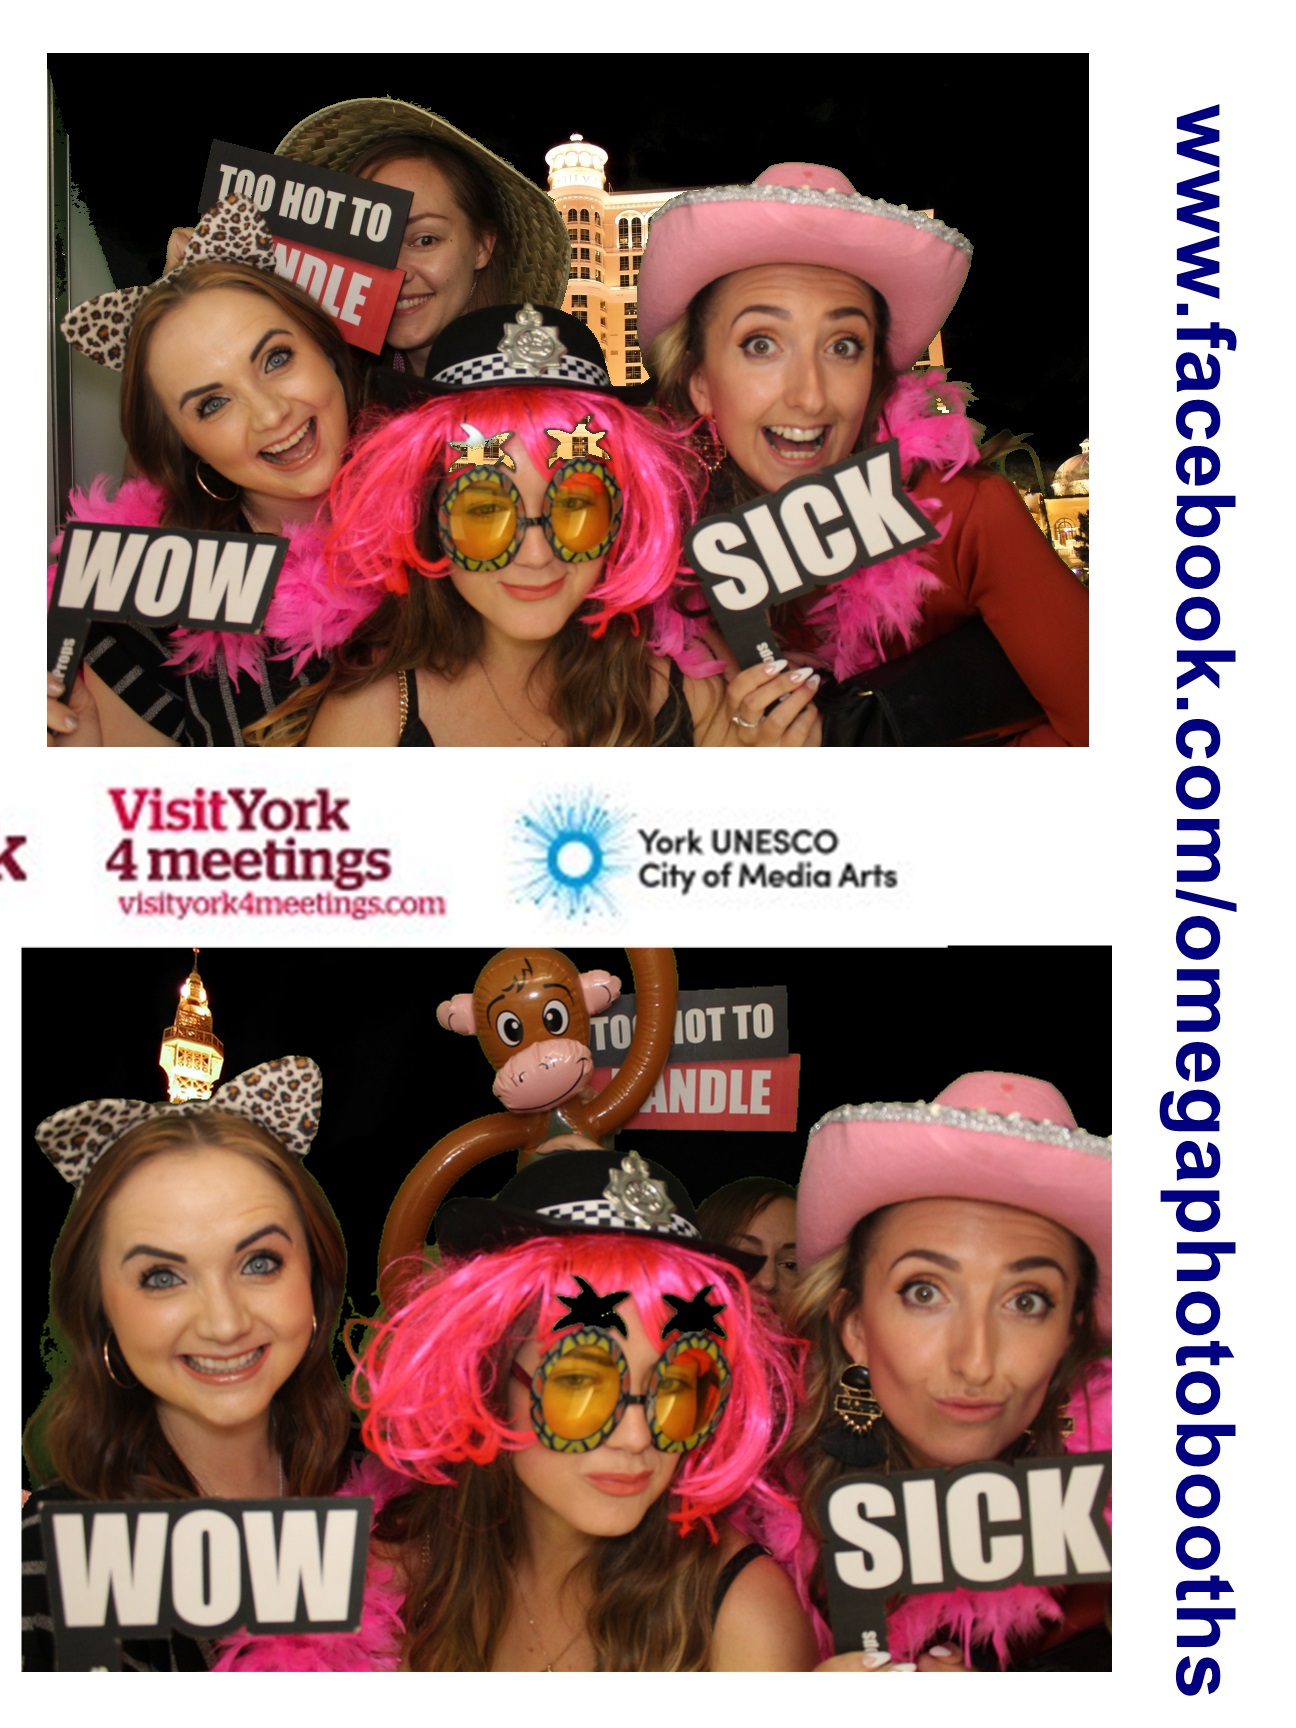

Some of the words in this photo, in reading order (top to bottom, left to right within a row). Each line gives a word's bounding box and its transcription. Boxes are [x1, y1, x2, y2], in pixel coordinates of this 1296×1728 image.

[219, 164, 276, 212] TOO
[278, 180, 346, 230] HOT
[350, 196, 392, 243] TO
[273, 243, 372, 326] NDLE
[58, 529, 276, 625] WOW
[692, 454, 925, 612] SICK
[590, 1014, 636, 1050] TO
[732, 1003, 774, 1040] TO
[611, 1069, 772, 1115] ANDLE
[52, 1508, 358, 1628] WOW
[827, 1464, 1112, 1591] SICK
